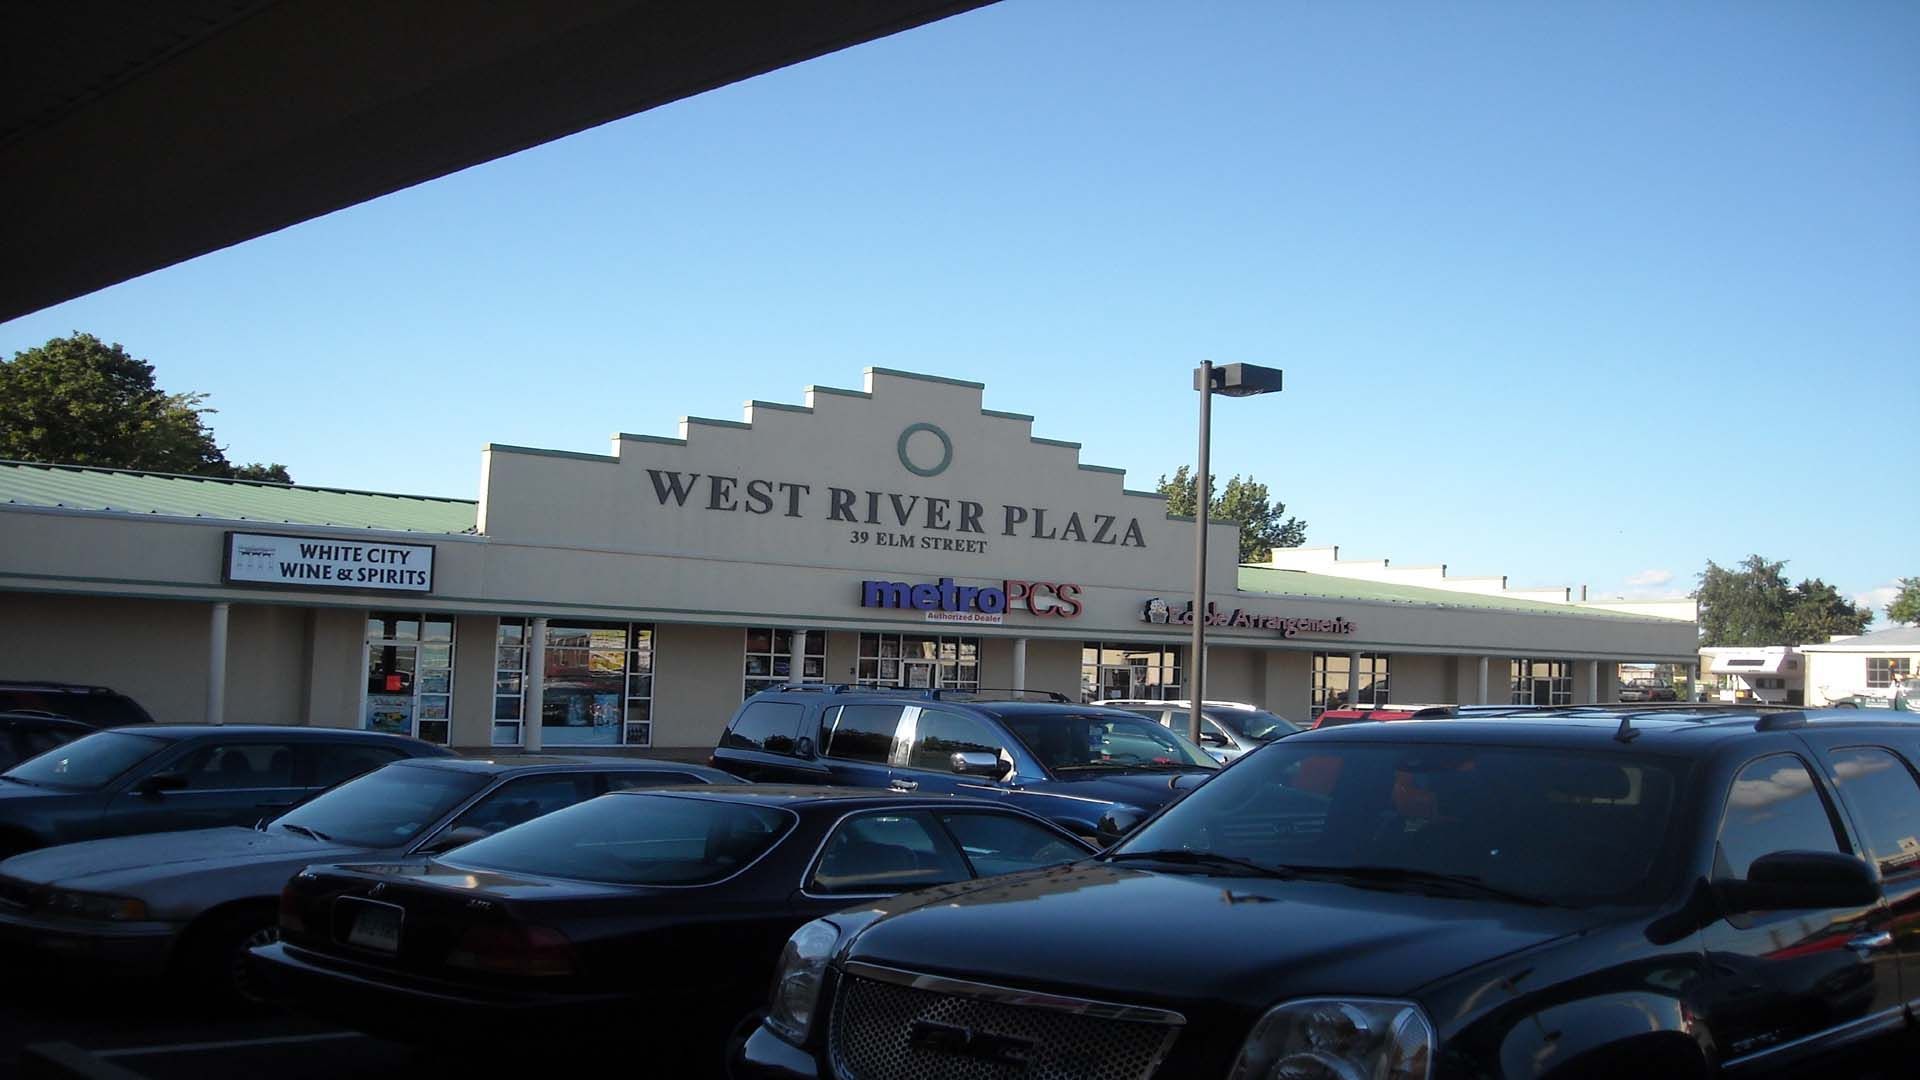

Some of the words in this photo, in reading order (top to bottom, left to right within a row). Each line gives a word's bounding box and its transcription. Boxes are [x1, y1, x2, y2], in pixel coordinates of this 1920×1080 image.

[646, 469, 810, 518] WEST
[826, 487, 986, 533] RIVER
[1001, 504, 1147, 547] PLAZA
[300, 543, 362, 562] WHITE
[367, 548, 411, 565] CITY
[850, 531, 869, 544] 39
[876, 533, 915, 548] ELM
[921, 537, 987, 554] STREET
[280, 562, 332, 580] WINE
[337, 568, 353, 581] &
[357, 567, 427, 585] SPIRITS
[861, 578, 1083, 618] metroPCS
[927, 611, 974, 622] Authorized
[974, 614, 1001, 624] Dealer
